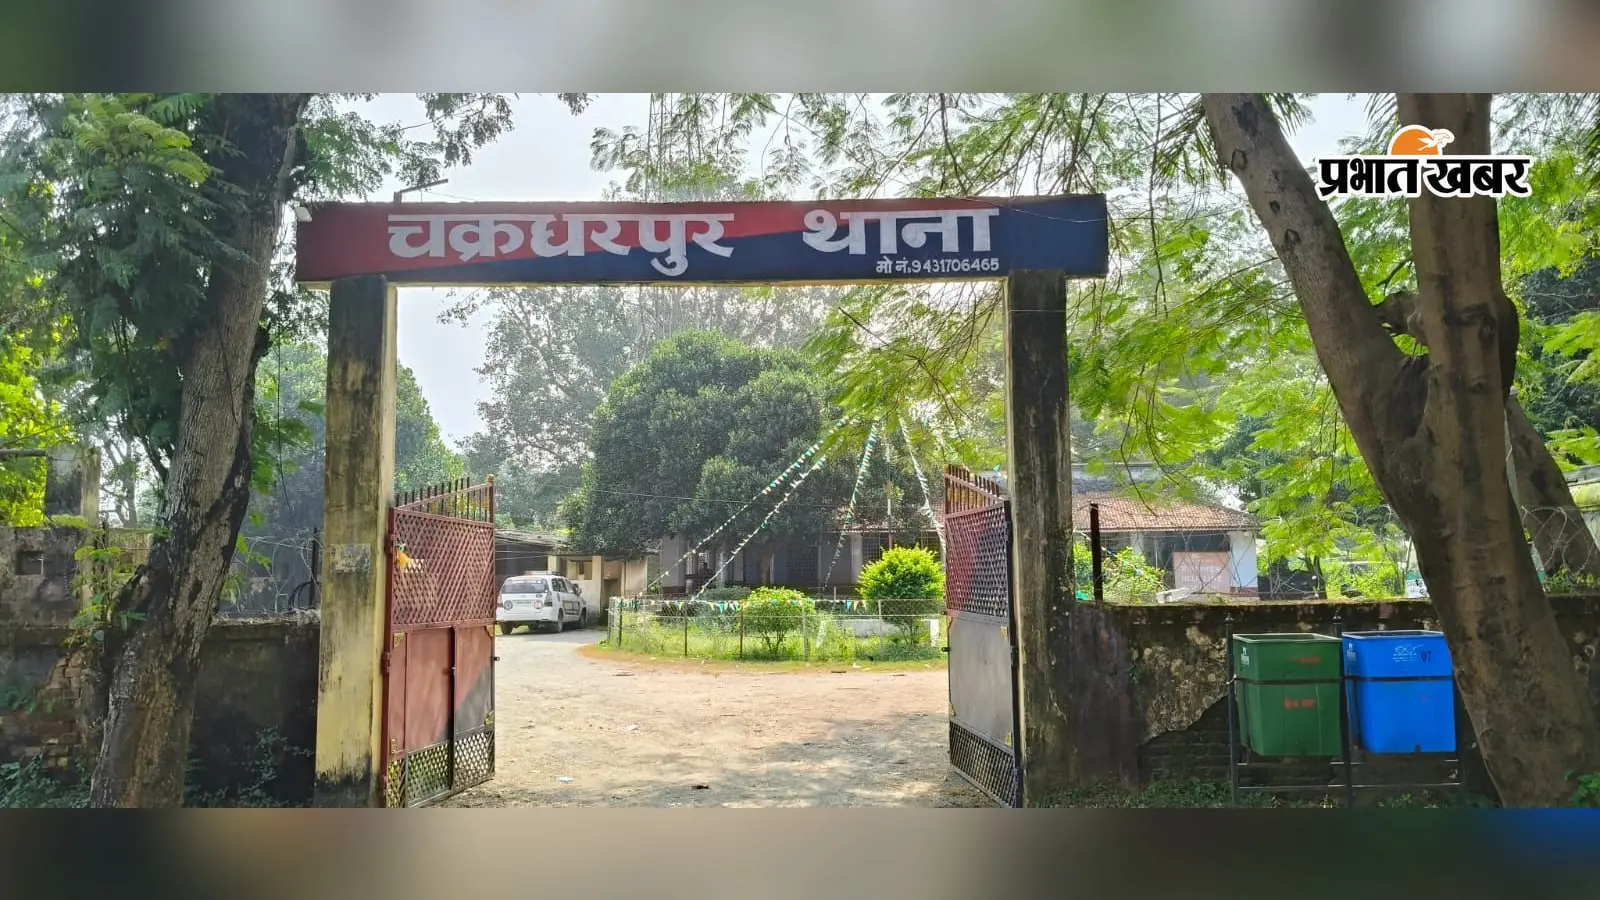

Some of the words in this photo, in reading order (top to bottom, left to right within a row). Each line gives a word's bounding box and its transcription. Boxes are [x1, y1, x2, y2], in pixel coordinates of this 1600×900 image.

[387, 213, 735, 277] चक्रधरपुर
[802, 207, 1000, 255] थाना
[876, 255, 893, 274] मो
